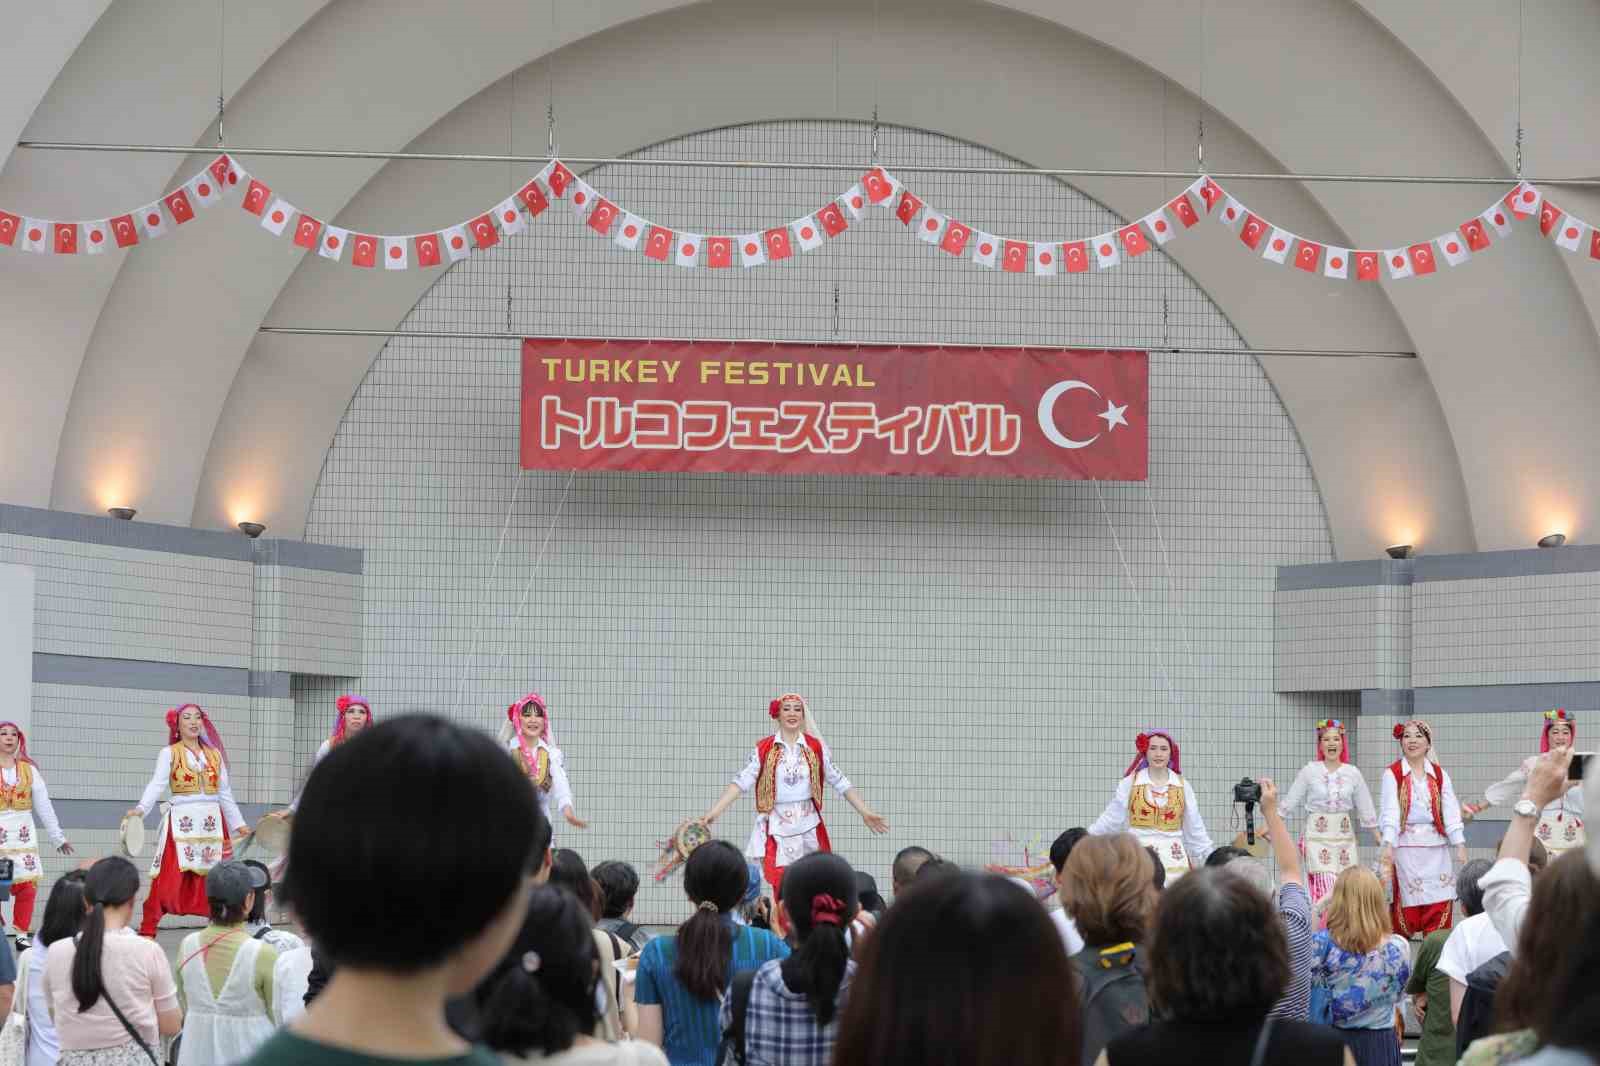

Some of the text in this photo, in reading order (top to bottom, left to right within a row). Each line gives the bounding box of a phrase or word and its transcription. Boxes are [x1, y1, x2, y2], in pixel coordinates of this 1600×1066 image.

[541, 358, 876, 388] TURKEY FESTIVAL
[540, 396, 1022, 456] トルコフェスティバル
